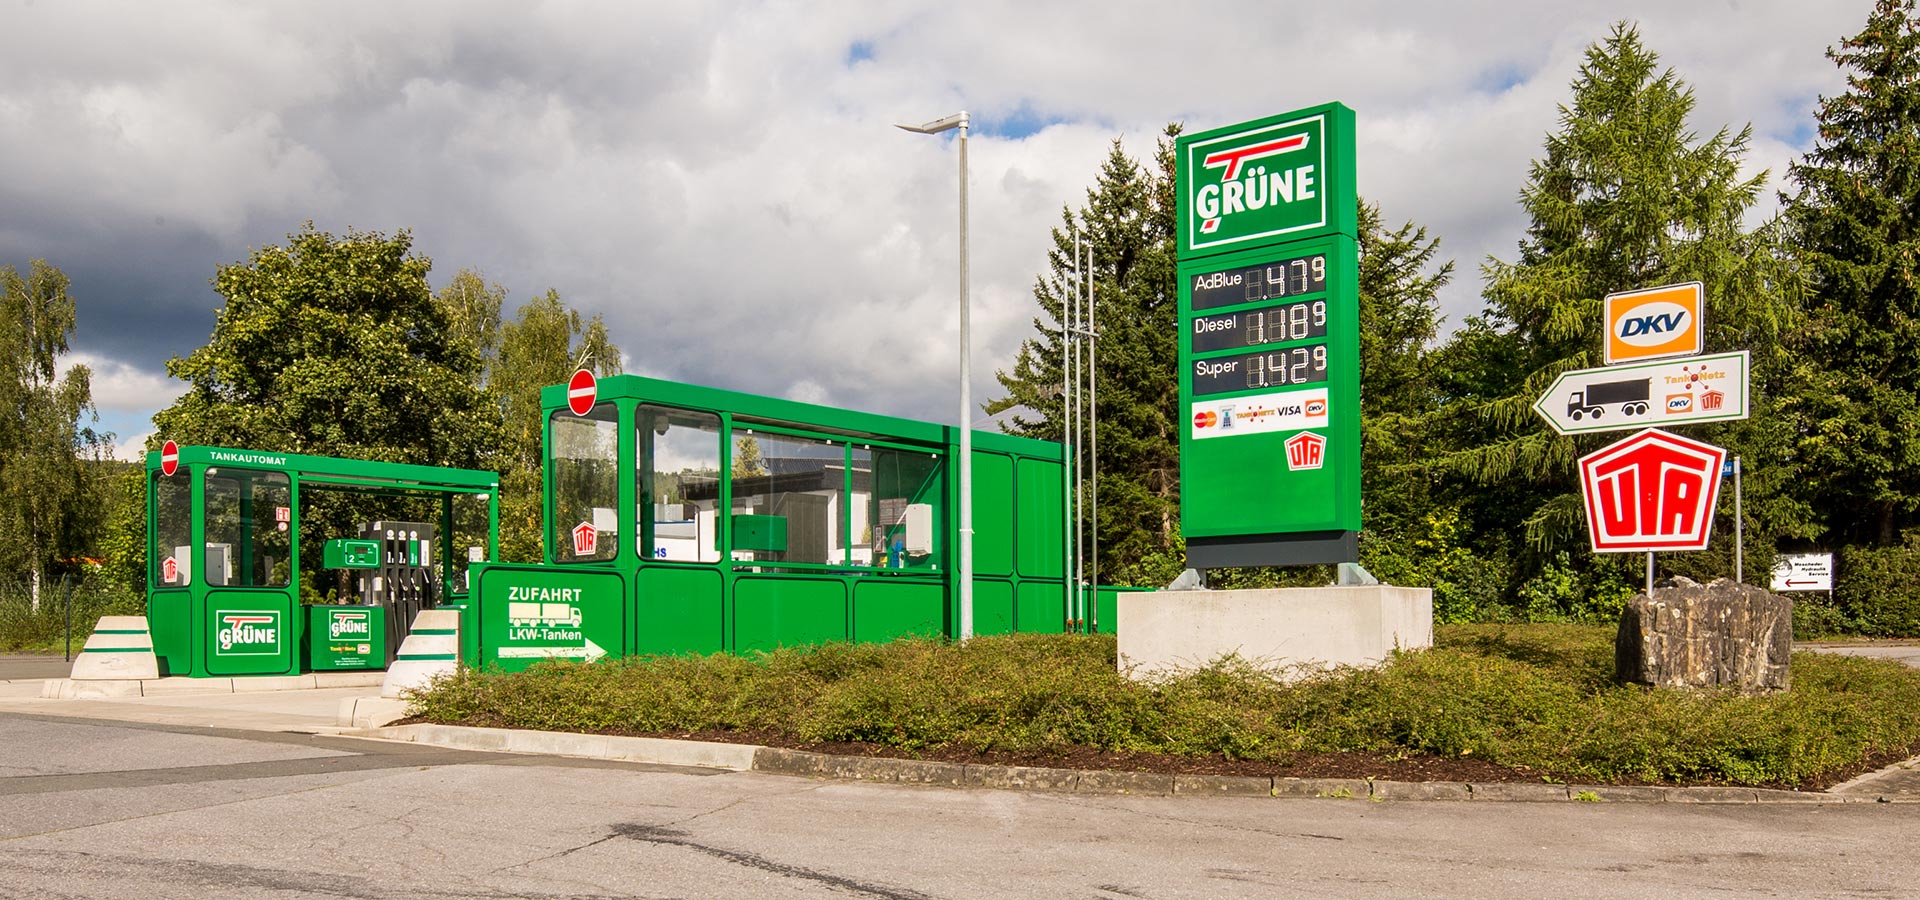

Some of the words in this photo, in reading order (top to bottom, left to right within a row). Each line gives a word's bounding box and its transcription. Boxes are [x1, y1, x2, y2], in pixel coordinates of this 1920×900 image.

[1196, 164, 1315, 220] GRÜNE
[1194, 272, 1243, 292] AdBlue
[1195, 315, 1237, 334] Diesel
[1620, 310, 1686, 337] DKV
[1196, 360, 1239, 379] Super
[1307, 404, 1323, 412] DKV
[1701, 392, 1723, 409] UTA
[1277, 405, 1302, 416] VISA
[210, 451, 287, 465] TANKAUTOMAT
[1289, 435, 1322, 466] UTA
[1595, 443, 1708, 537] UTA
[575, 525, 595, 551] UTA
[349, 554, 355, 563] 2
[509, 586, 582, 602] ZUFAHRT
[219, 625, 276, 644] GRÜNE
[331, 620, 368, 633] GRÜNE
[509, 628, 582, 640] LKW-Tanken
